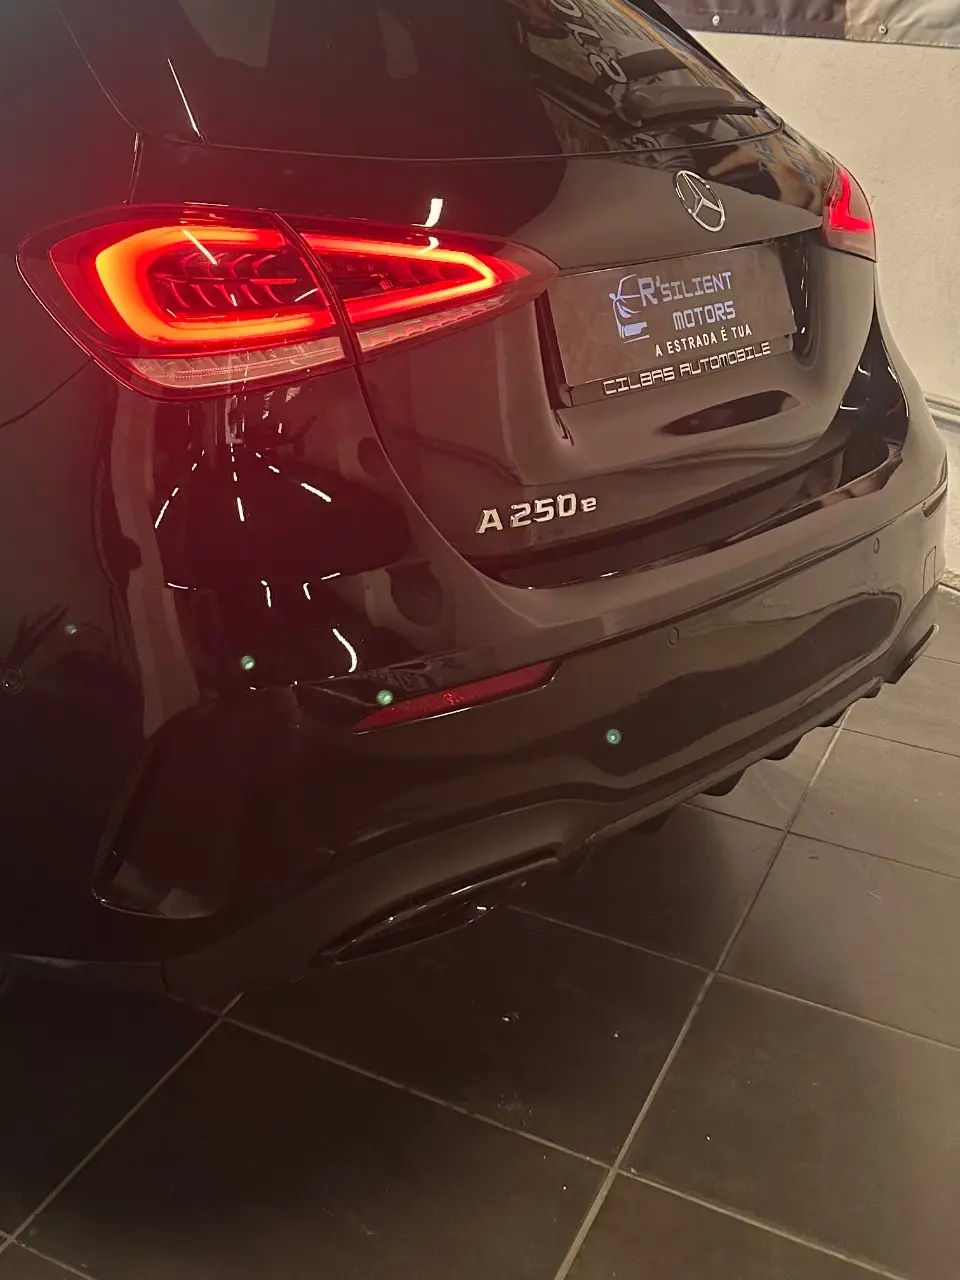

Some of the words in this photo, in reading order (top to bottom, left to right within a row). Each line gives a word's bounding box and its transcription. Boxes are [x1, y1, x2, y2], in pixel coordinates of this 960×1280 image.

[638, 272, 732, 307] R'SILIENT
[673, 301, 736, 330] MOTORS
[655, 344, 663, 357] A
[667, 332, 718, 354] ESTRADA
[721, 326, 728, 342] É
[731, 324, 753, 339] TUA
[603, 366, 675, 395] CILBAS
[679, 341, 772, 378] AUTOMOBILE
[476, 508, 503, 534] A
